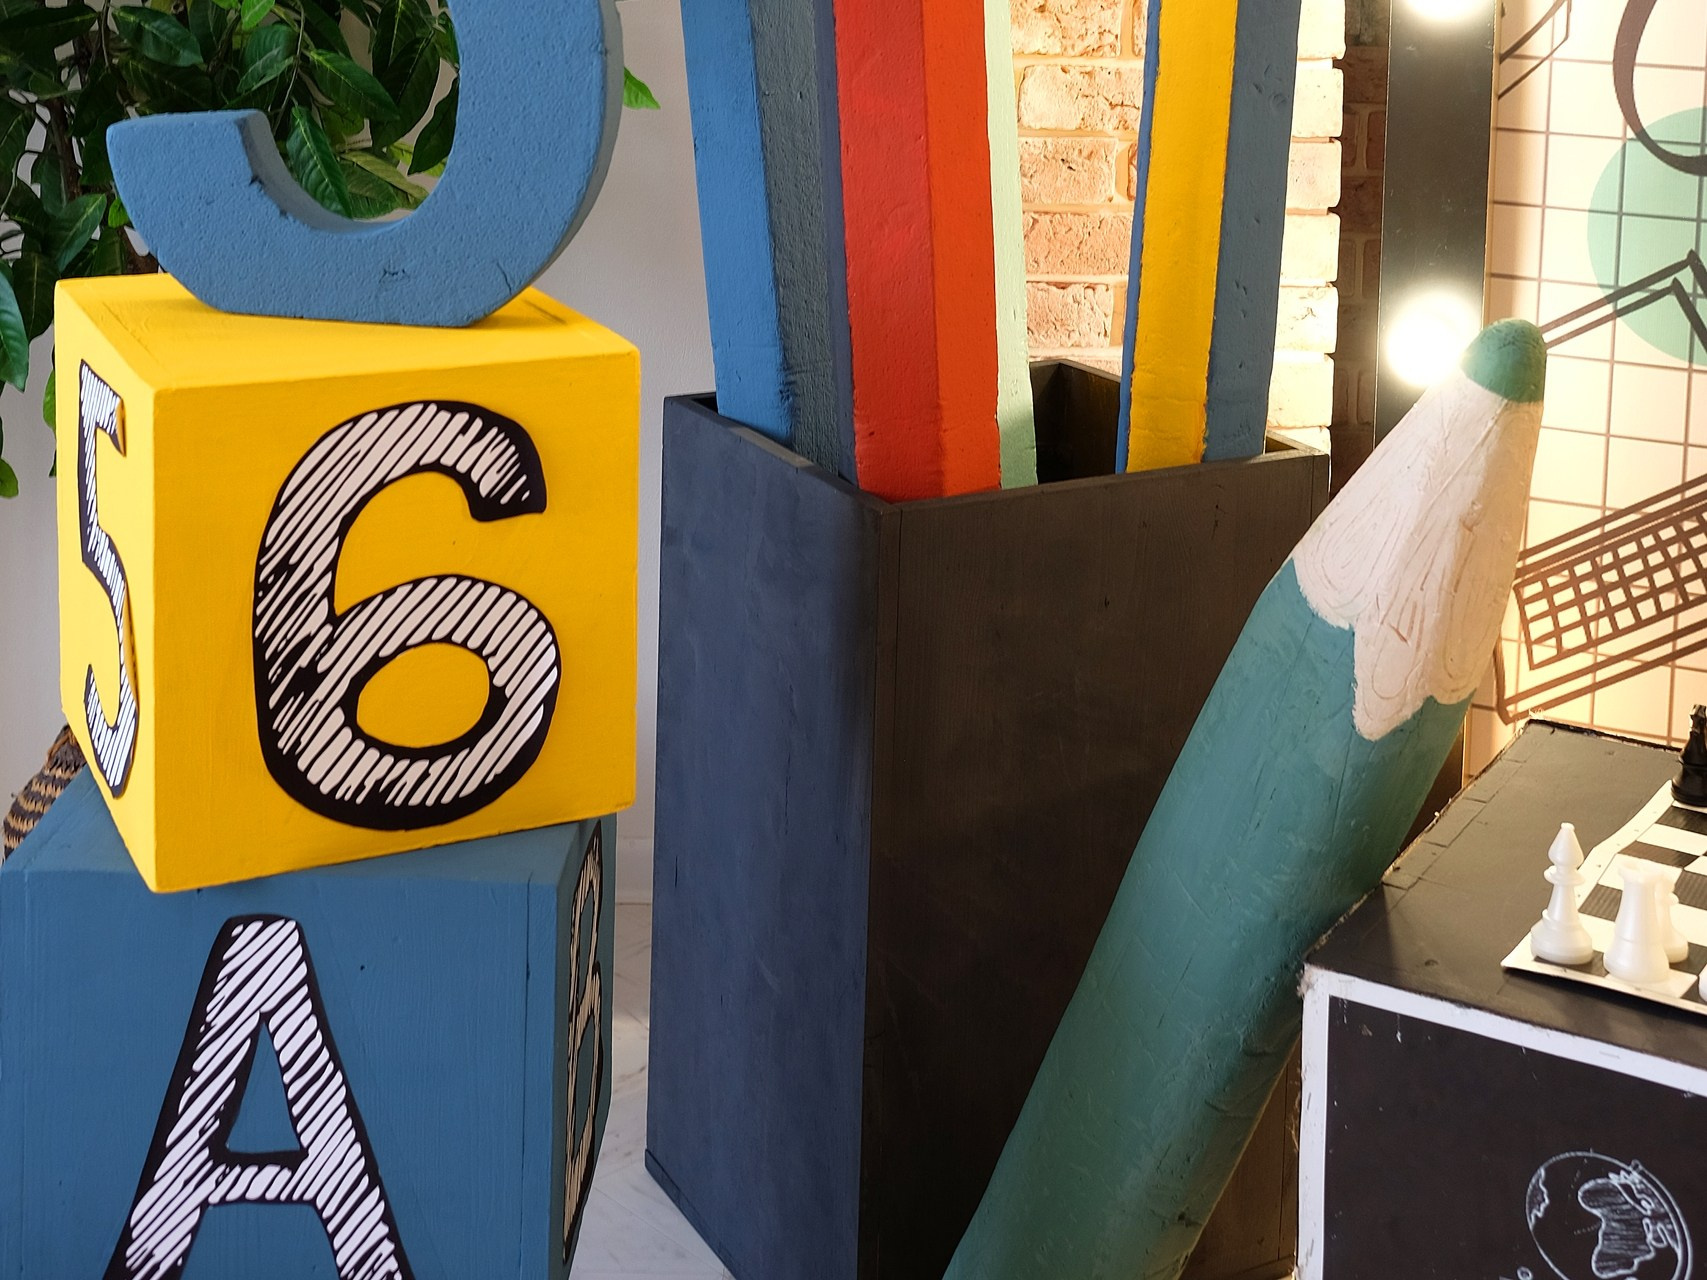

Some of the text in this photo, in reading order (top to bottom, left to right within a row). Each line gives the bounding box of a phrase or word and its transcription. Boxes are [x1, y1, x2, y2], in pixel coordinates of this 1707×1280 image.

[78, 358, 140, 799] 5
[252, 400, 562, 832] 6
[102, 913, 416, 1280] A
[563, 819, 603, 1265] B
